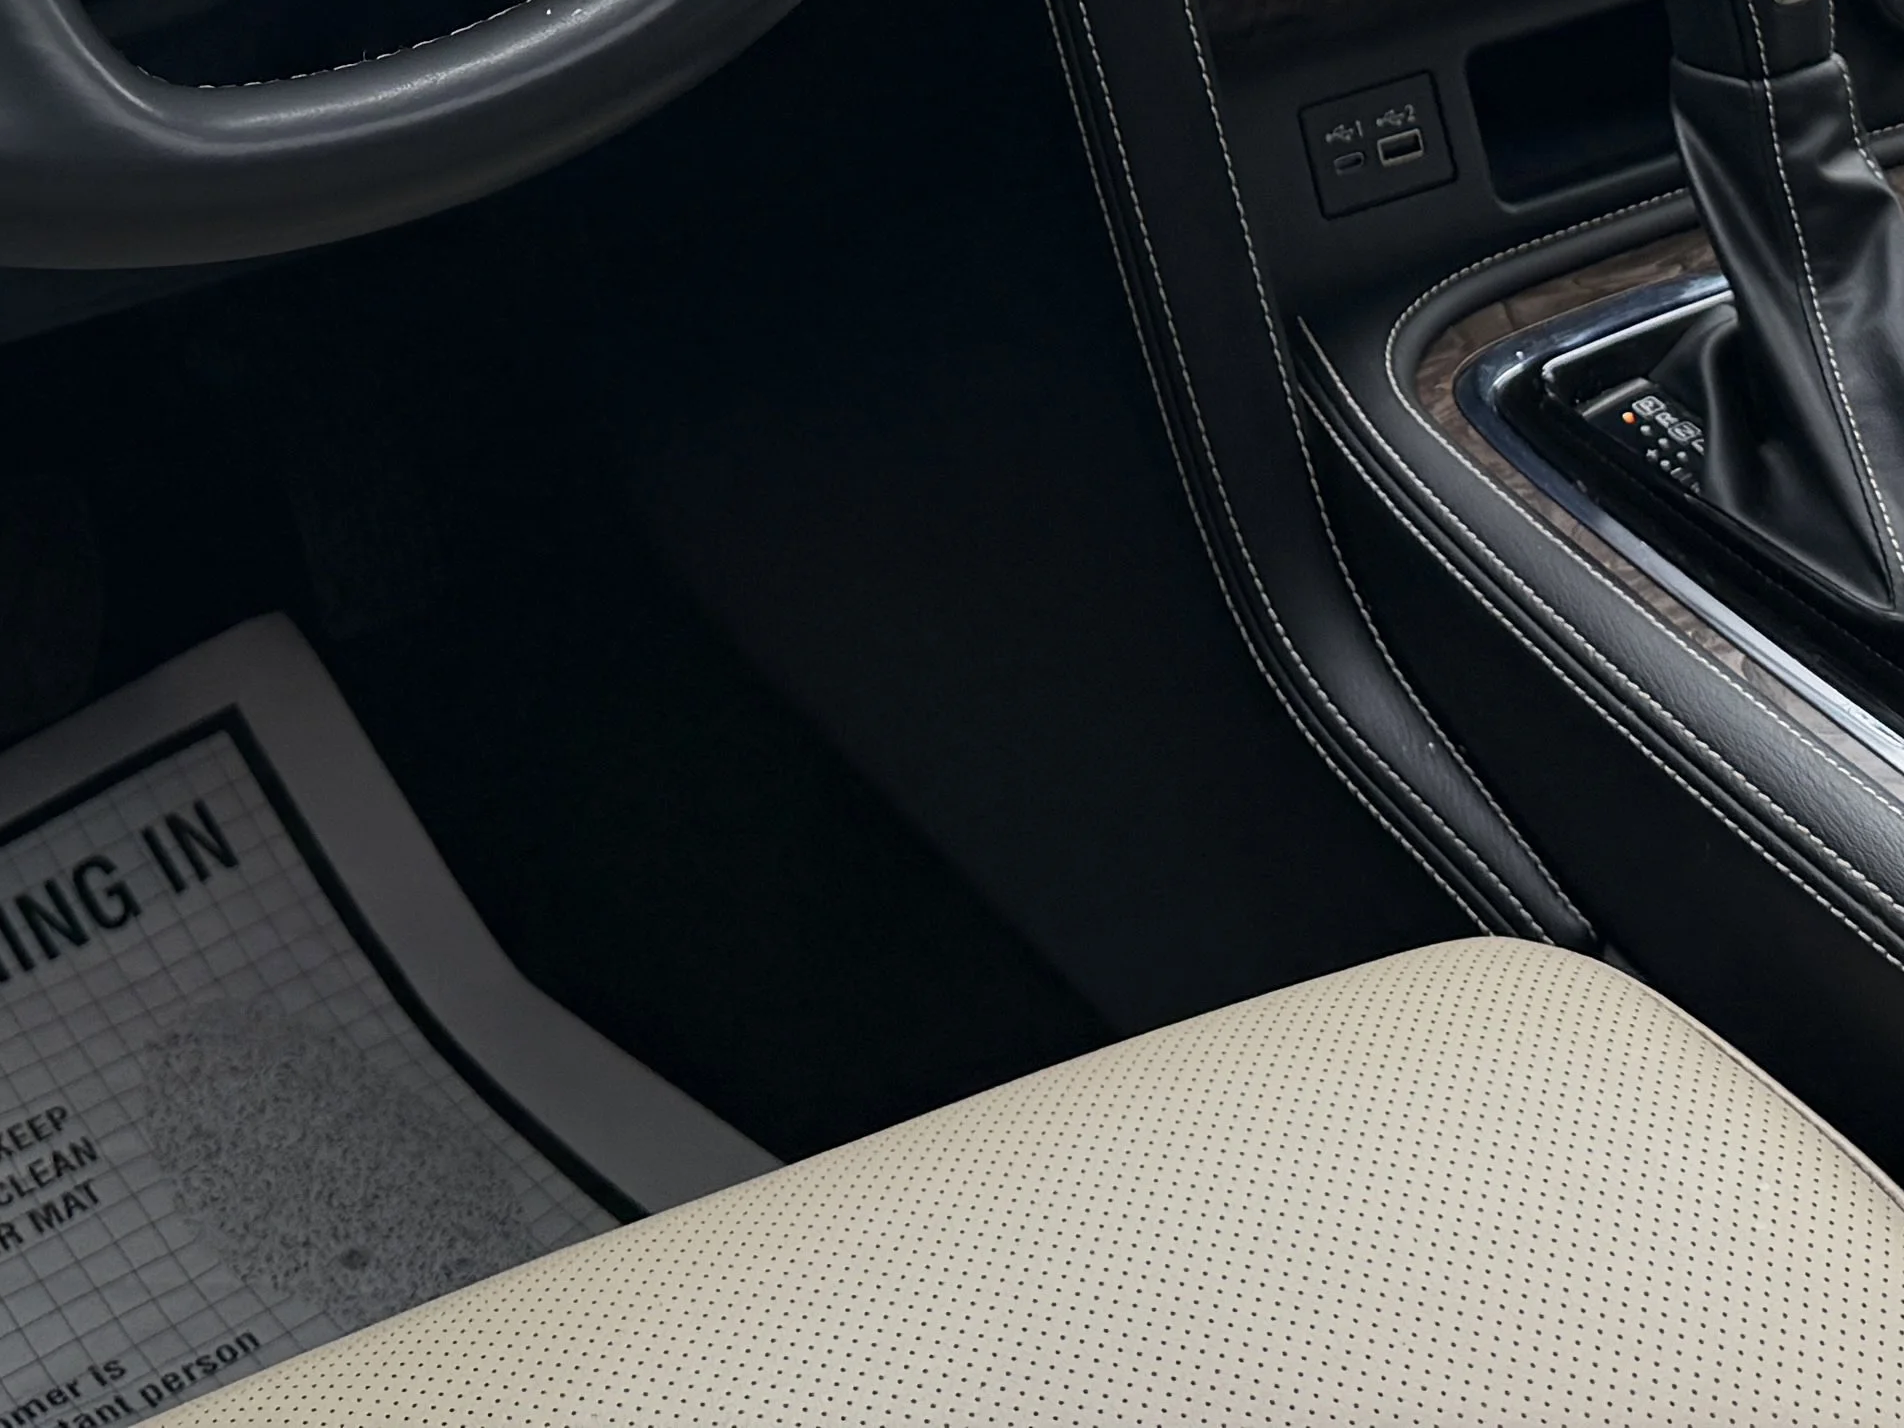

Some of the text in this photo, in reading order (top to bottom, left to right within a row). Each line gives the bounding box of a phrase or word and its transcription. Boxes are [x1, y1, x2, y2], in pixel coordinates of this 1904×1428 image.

[1404, 103, 1417, 124] 2
[138, 797, 240, 896] IN
[26, 1177, 106, 1234] MAT
[86, 1357, 128, 1389] is
[139, 1330, 262, 1409] person
